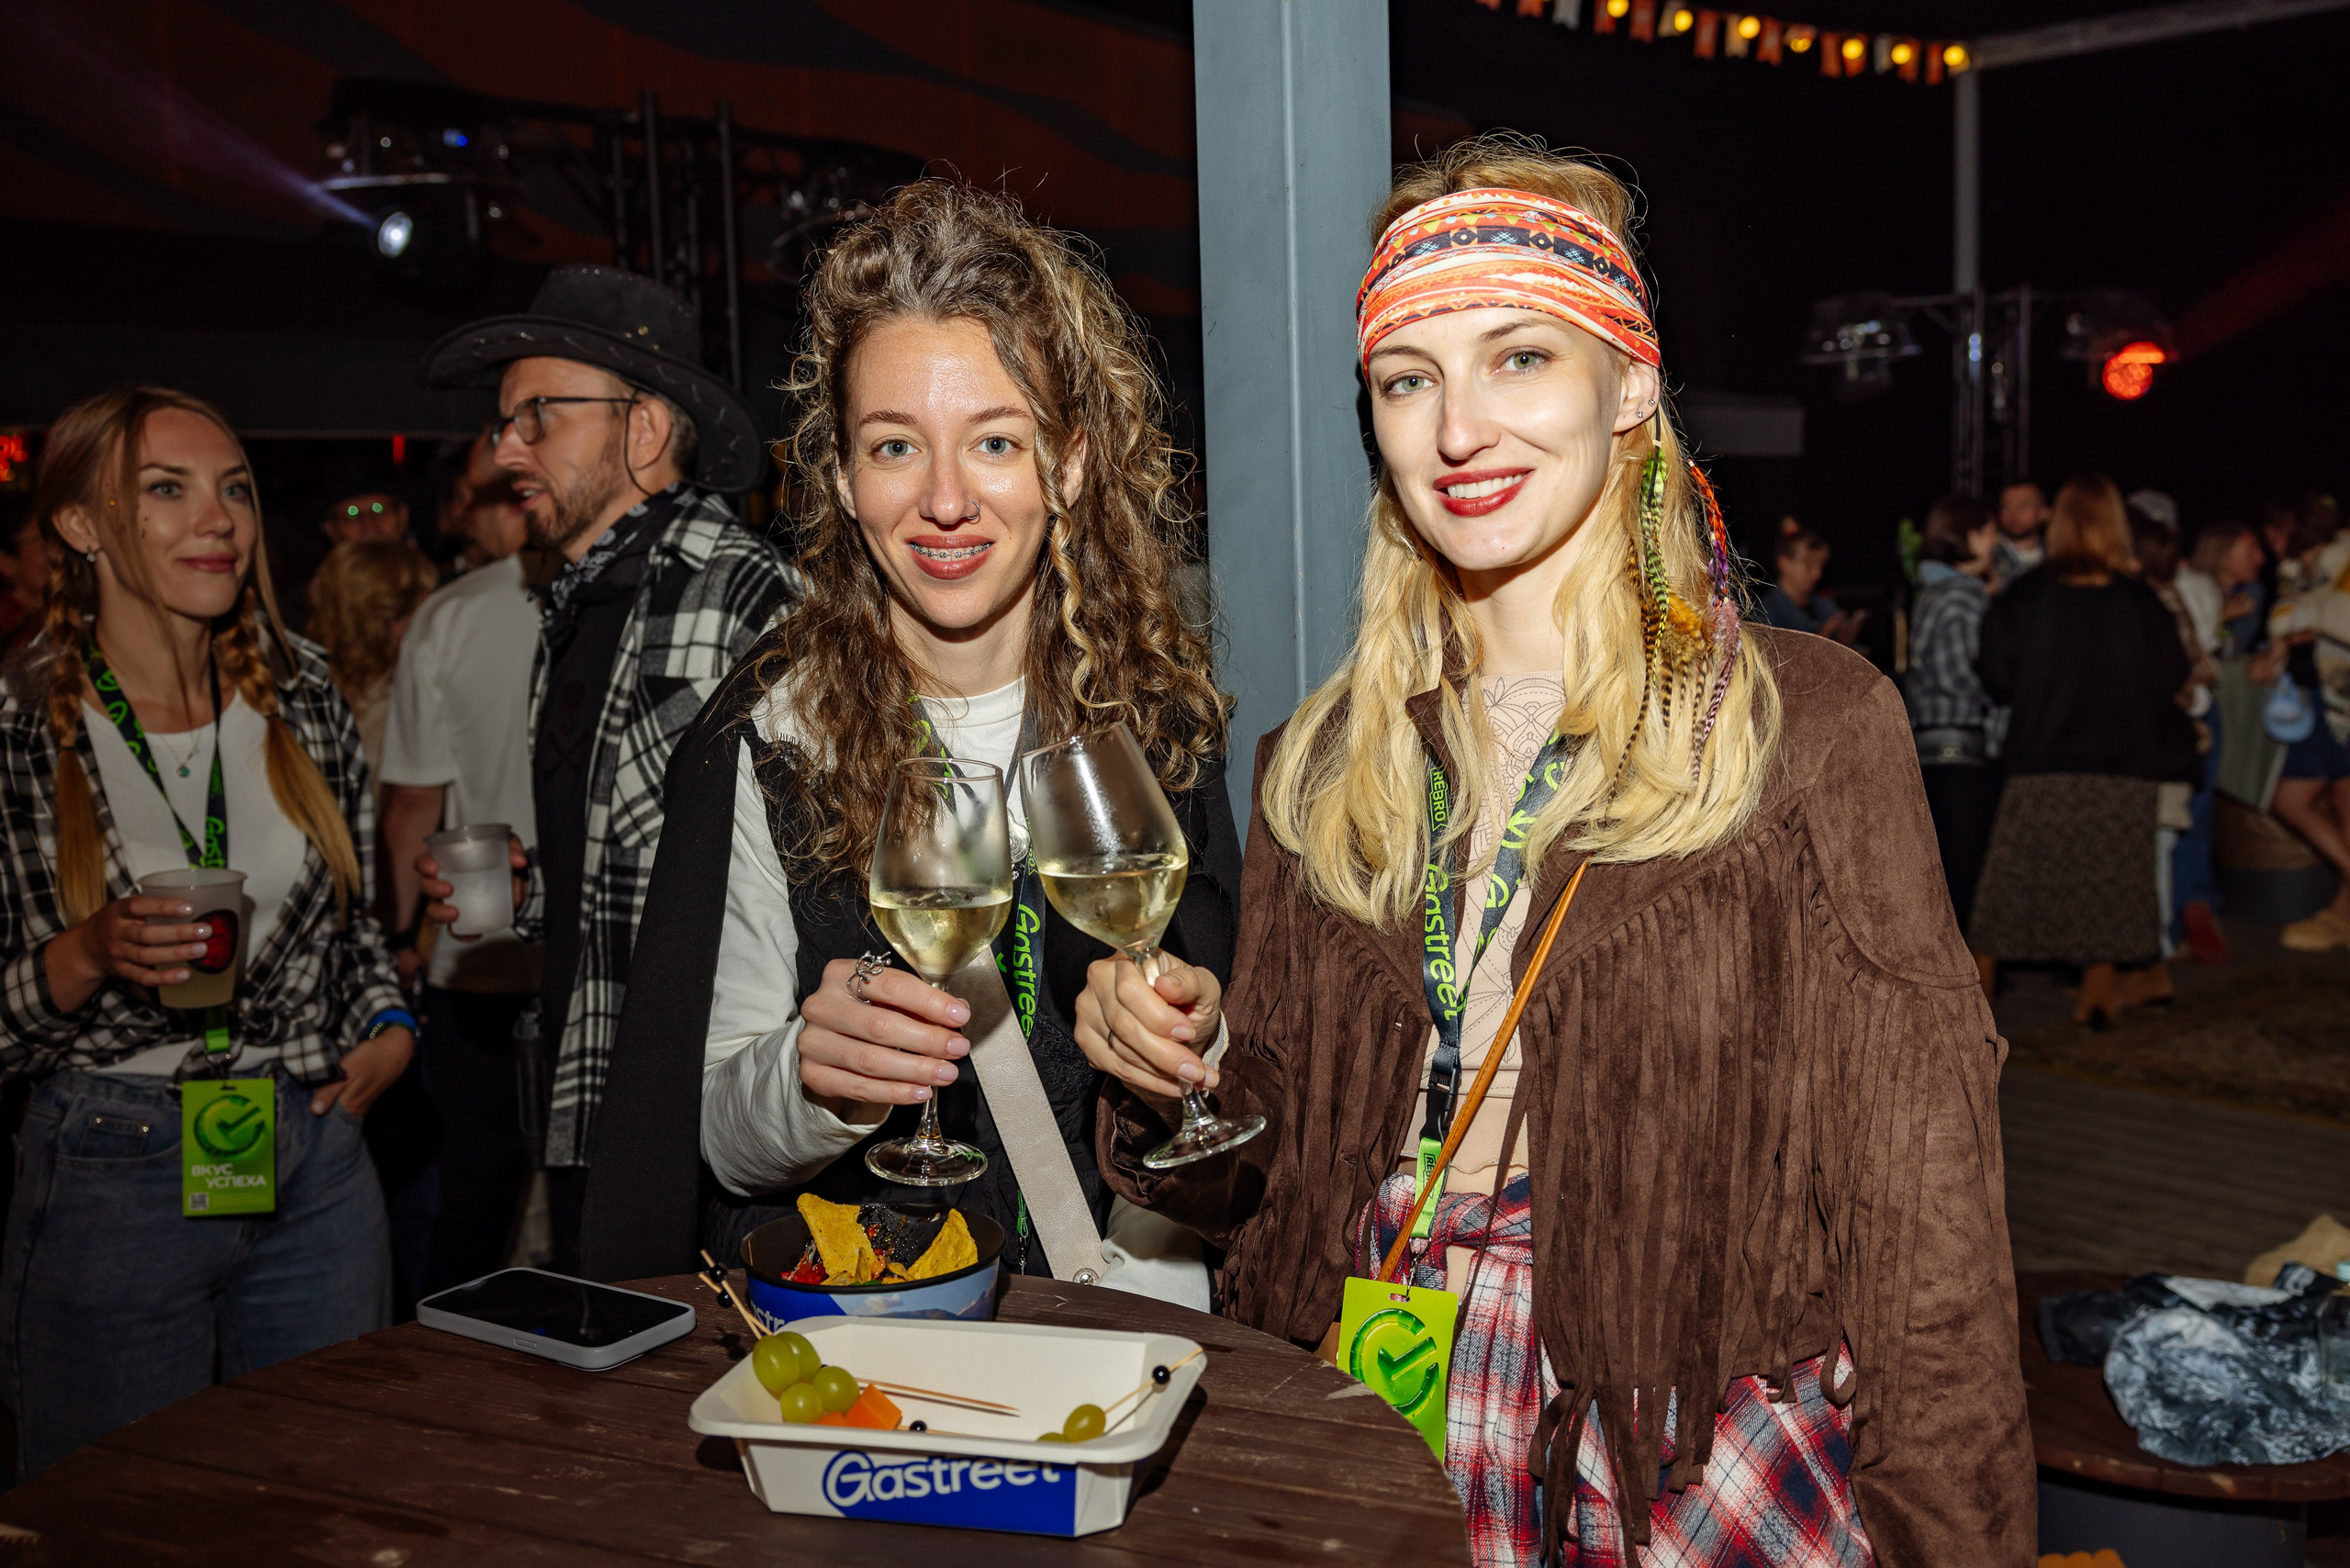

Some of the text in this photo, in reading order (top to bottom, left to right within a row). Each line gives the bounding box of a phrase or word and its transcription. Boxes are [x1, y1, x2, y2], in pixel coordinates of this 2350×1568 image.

[1432, 771, 1447, 823] REBRO
[206, 815, 226, 868] Gast
[1013, 903, 1041, 1043] Gastree
[191, 1162, 234, 1177] ВКУС
[205, 1174, 267, 1189] УСПЕХА
[825, 1450, 1060, 1507] Gastreet
